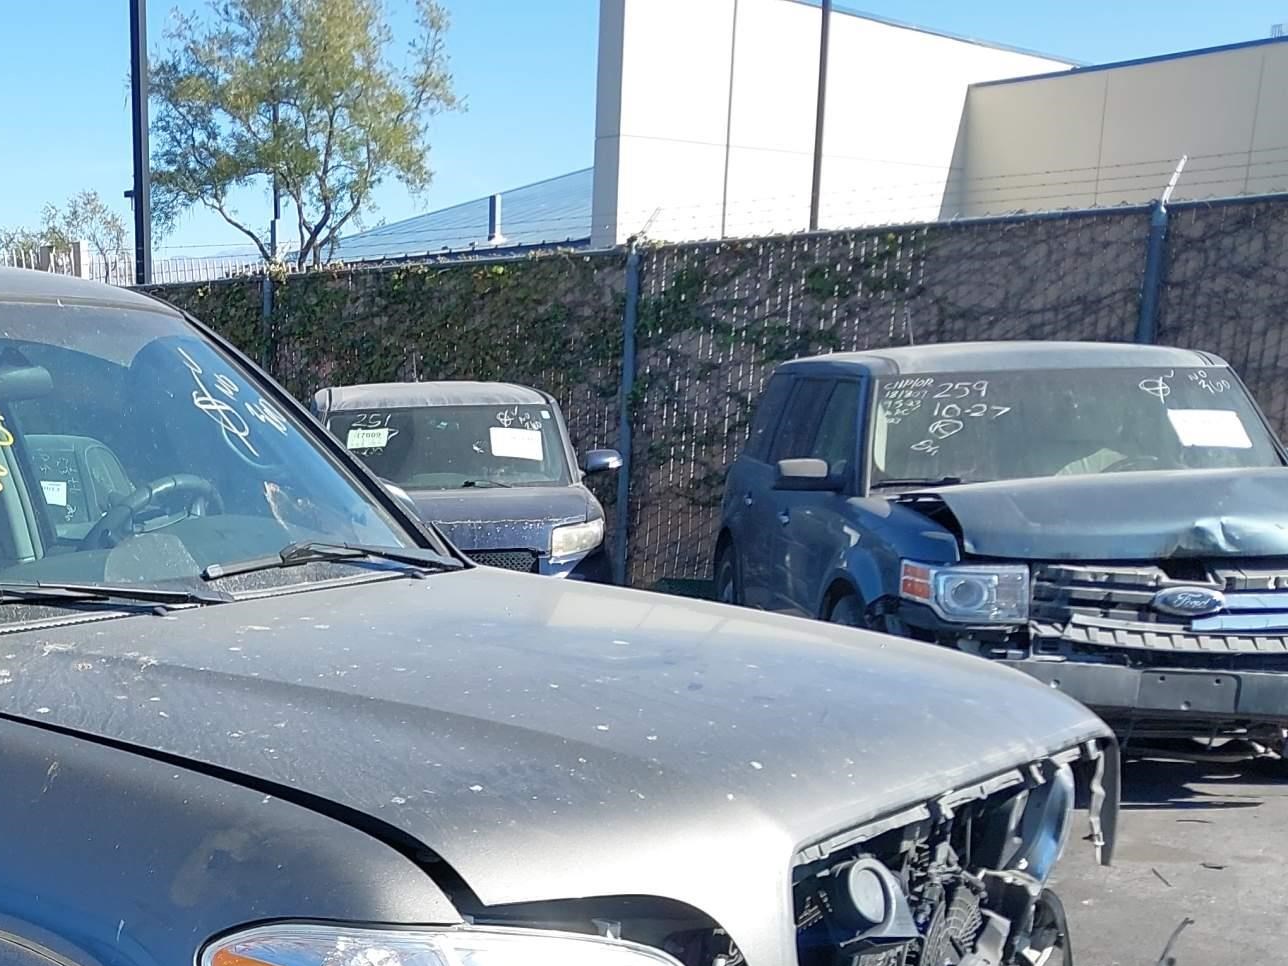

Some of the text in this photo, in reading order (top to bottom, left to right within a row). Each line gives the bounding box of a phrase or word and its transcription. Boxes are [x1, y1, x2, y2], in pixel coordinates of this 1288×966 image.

[931, 380, 990, 399] 259
[932, 401, 1012, 420] 10-27
[351, 413, 393, 428] 251
